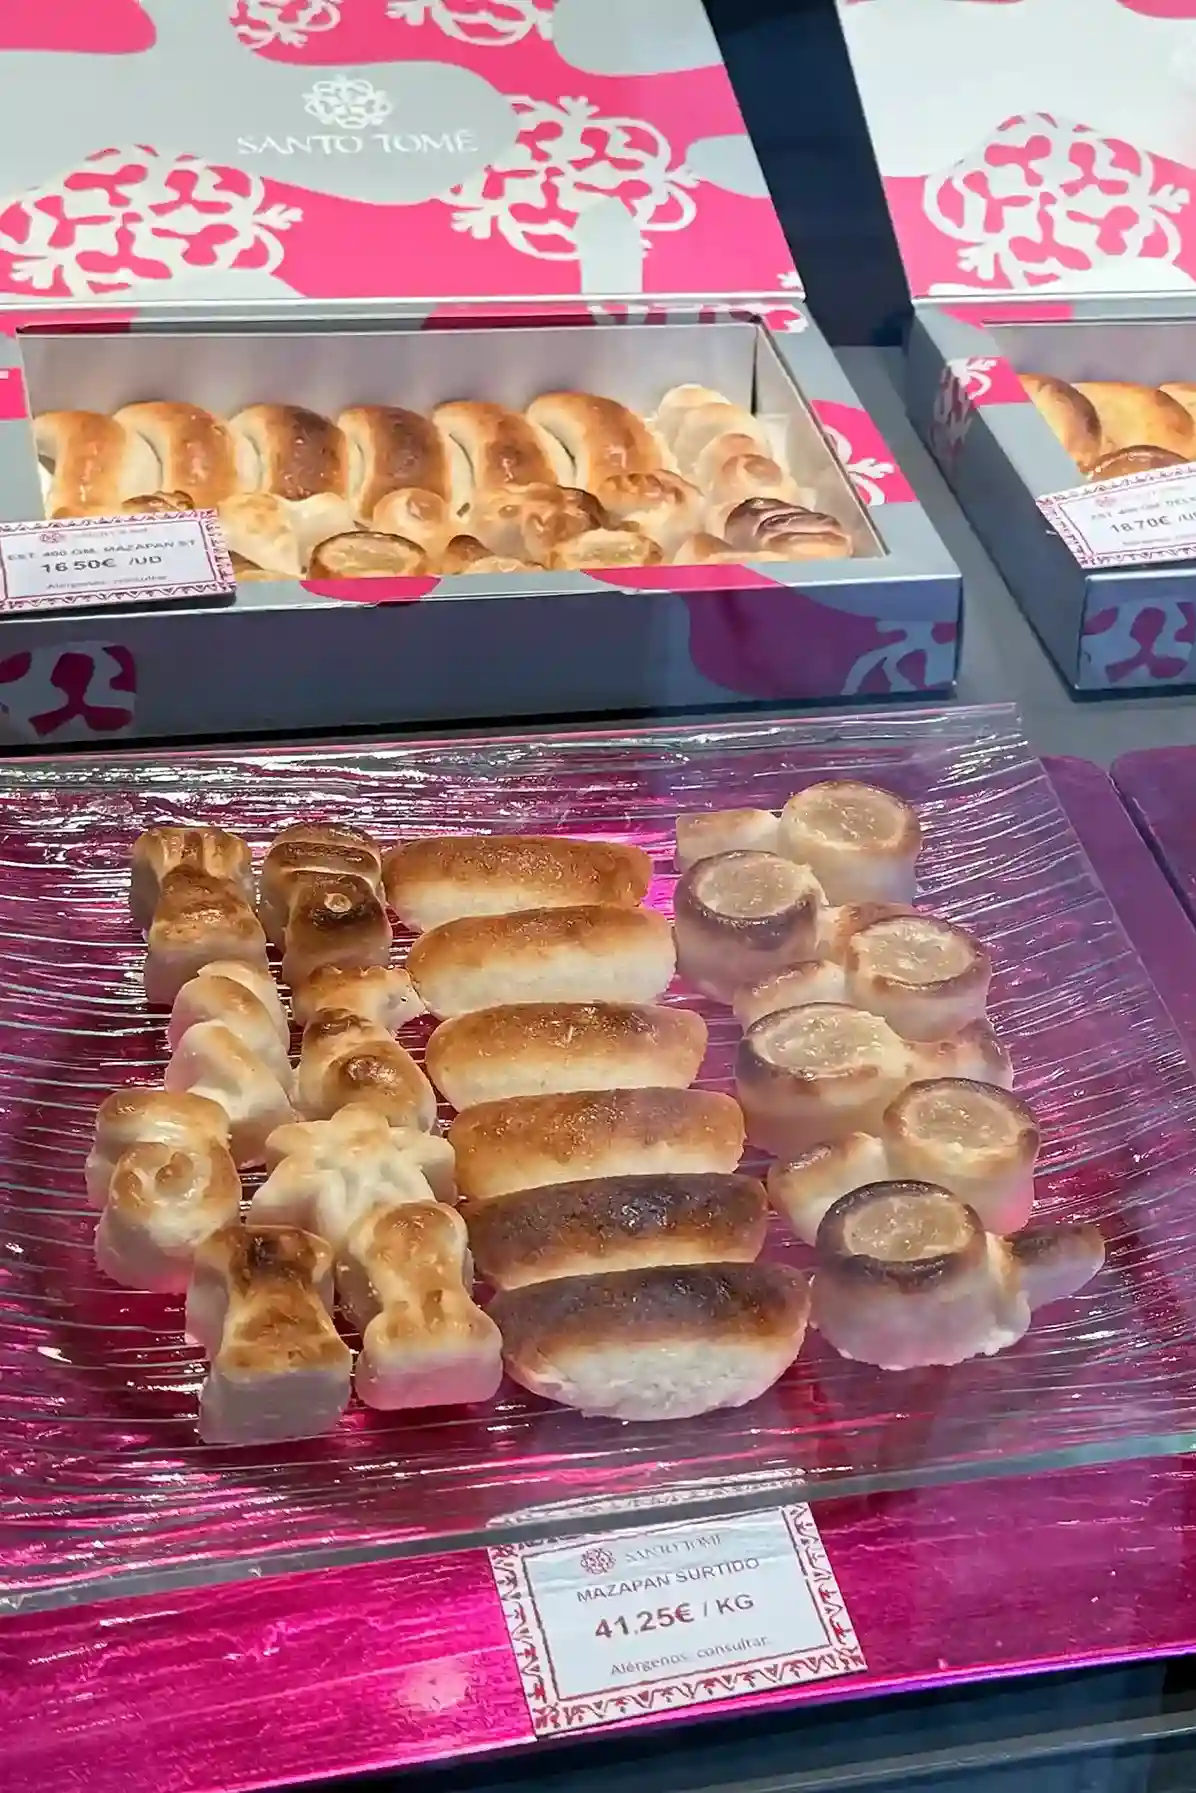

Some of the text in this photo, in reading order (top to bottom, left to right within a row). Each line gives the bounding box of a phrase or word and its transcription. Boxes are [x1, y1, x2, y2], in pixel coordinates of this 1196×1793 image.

[237, 134, 363, 156] SANTO
[1110, 515, 1172, 534] 1870€
[40, 557, 117, 574] 1650€
[576, 1557, 761, 1603] MAZAPAN SURTIDO
[594, 1602, 695, 1639] 41.25€
[715, 1593, 755, 1616] KG
